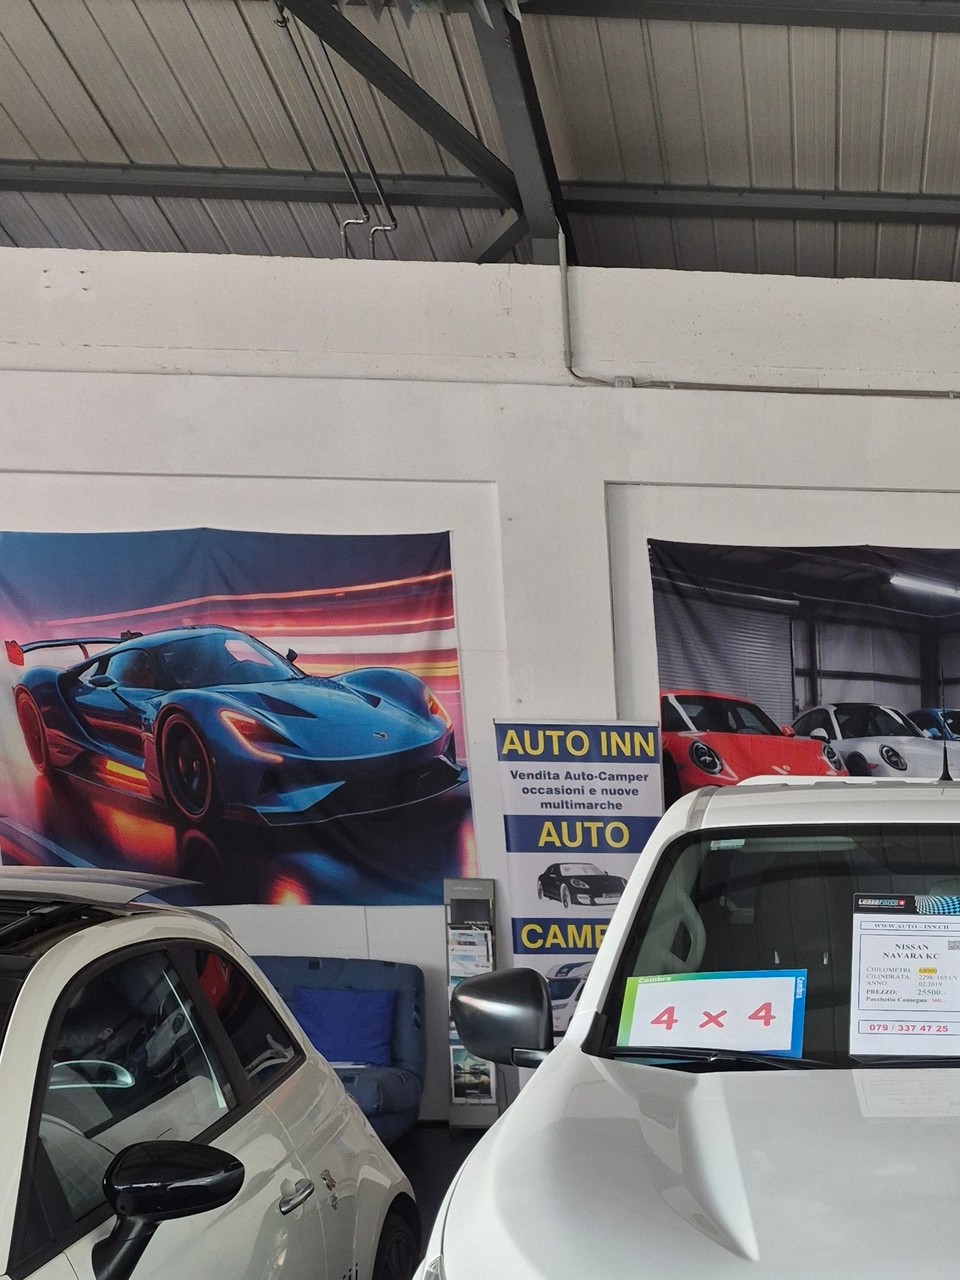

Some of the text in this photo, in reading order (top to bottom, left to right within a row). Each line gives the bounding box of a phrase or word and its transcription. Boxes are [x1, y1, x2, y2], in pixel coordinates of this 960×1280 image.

[501, 729, 655, 757] AUTO INN
[510, 770, 650, 784] Vendita Auto-Camper
[522, 785, 640, 797] occasioni e nuove
[540, 800, 623, 811] multimarche
[537, 821, 630, 849] AUTO
[895, 943, 929, 951] NISSAN
[883, 952, 923, 960] NAVARA
[638, 976, 672, 984] Cembra
[650, 1005, 679, 1031] 4
[747, 1001, 776, 1027] 4
[869, 1023, 889, 1031] 079
[898, 1024, 916, 1032] 337
[936, 1025, 949, 1033] 25
